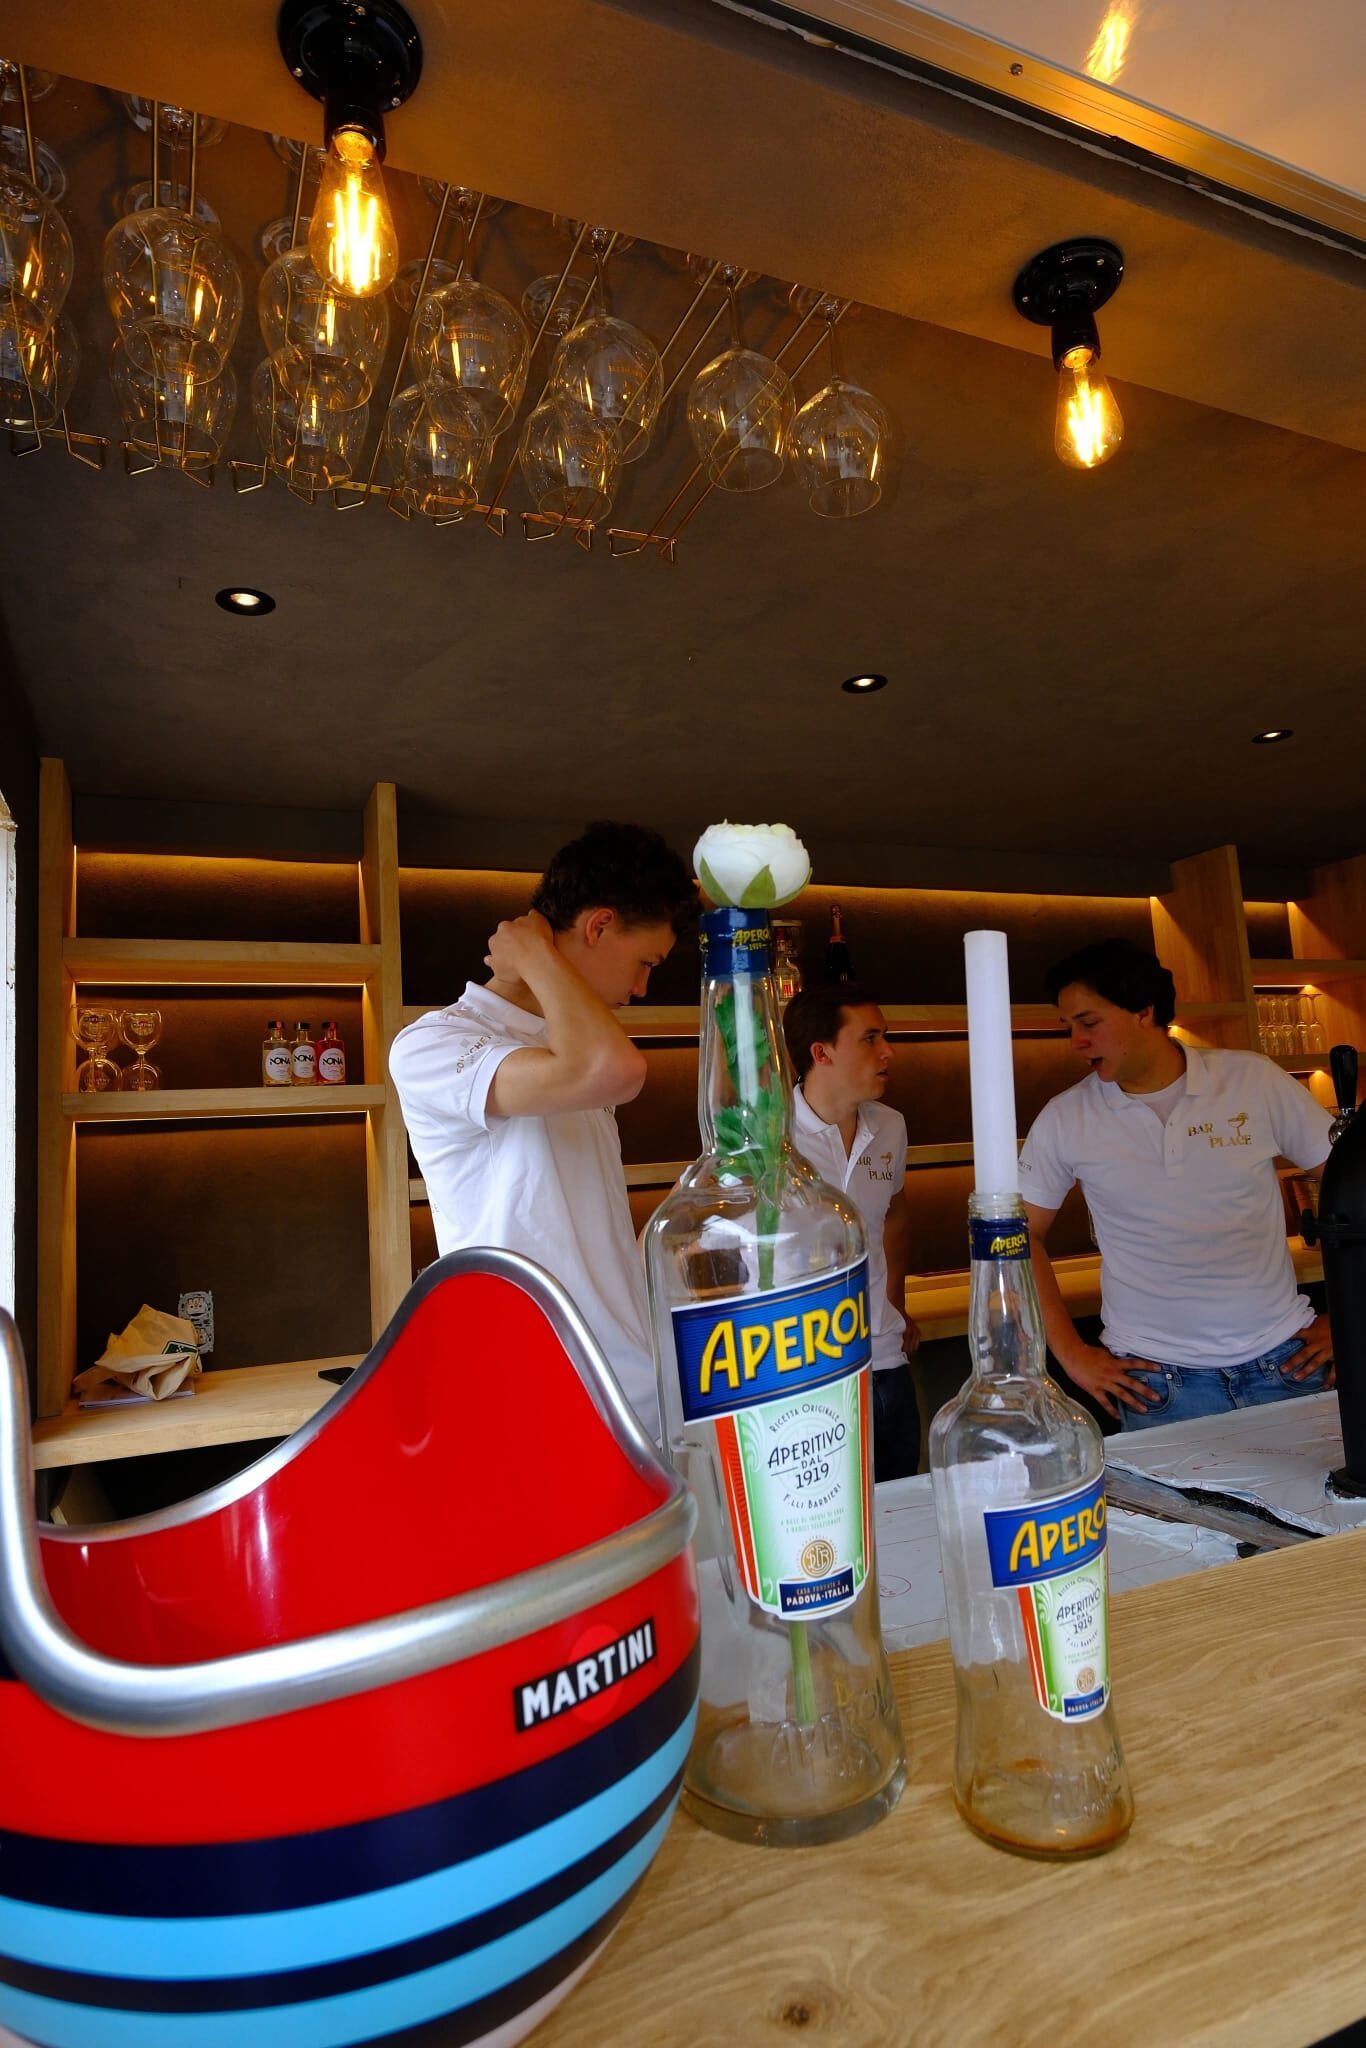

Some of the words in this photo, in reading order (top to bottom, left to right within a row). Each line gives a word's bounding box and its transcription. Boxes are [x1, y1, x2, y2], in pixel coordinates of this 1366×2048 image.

[732, 928, 770, 949] APERO
[1187, 1122, 1214, 1137] BAR
[1209, 1134, 1253, 1149] PLACE
[990, 1232, 1027, 1254] APEROL
[699, 1290, 869, 1394] APEROL
[768, 1408, 800, 1433] RICETTA
[767, 1423, 846, 1469] APERITIVO
[801, 1455, 823, 1470] DAL
[795, 1462, 830, 1490] 1919
[1009, 1494, 1107, 1572] APERO
[1056, 1587, 1101, 1621] APERITIVO
[1073, 1615, 1093, 1635] 1919
[521, 1622, 654, 1728] MARTINI
